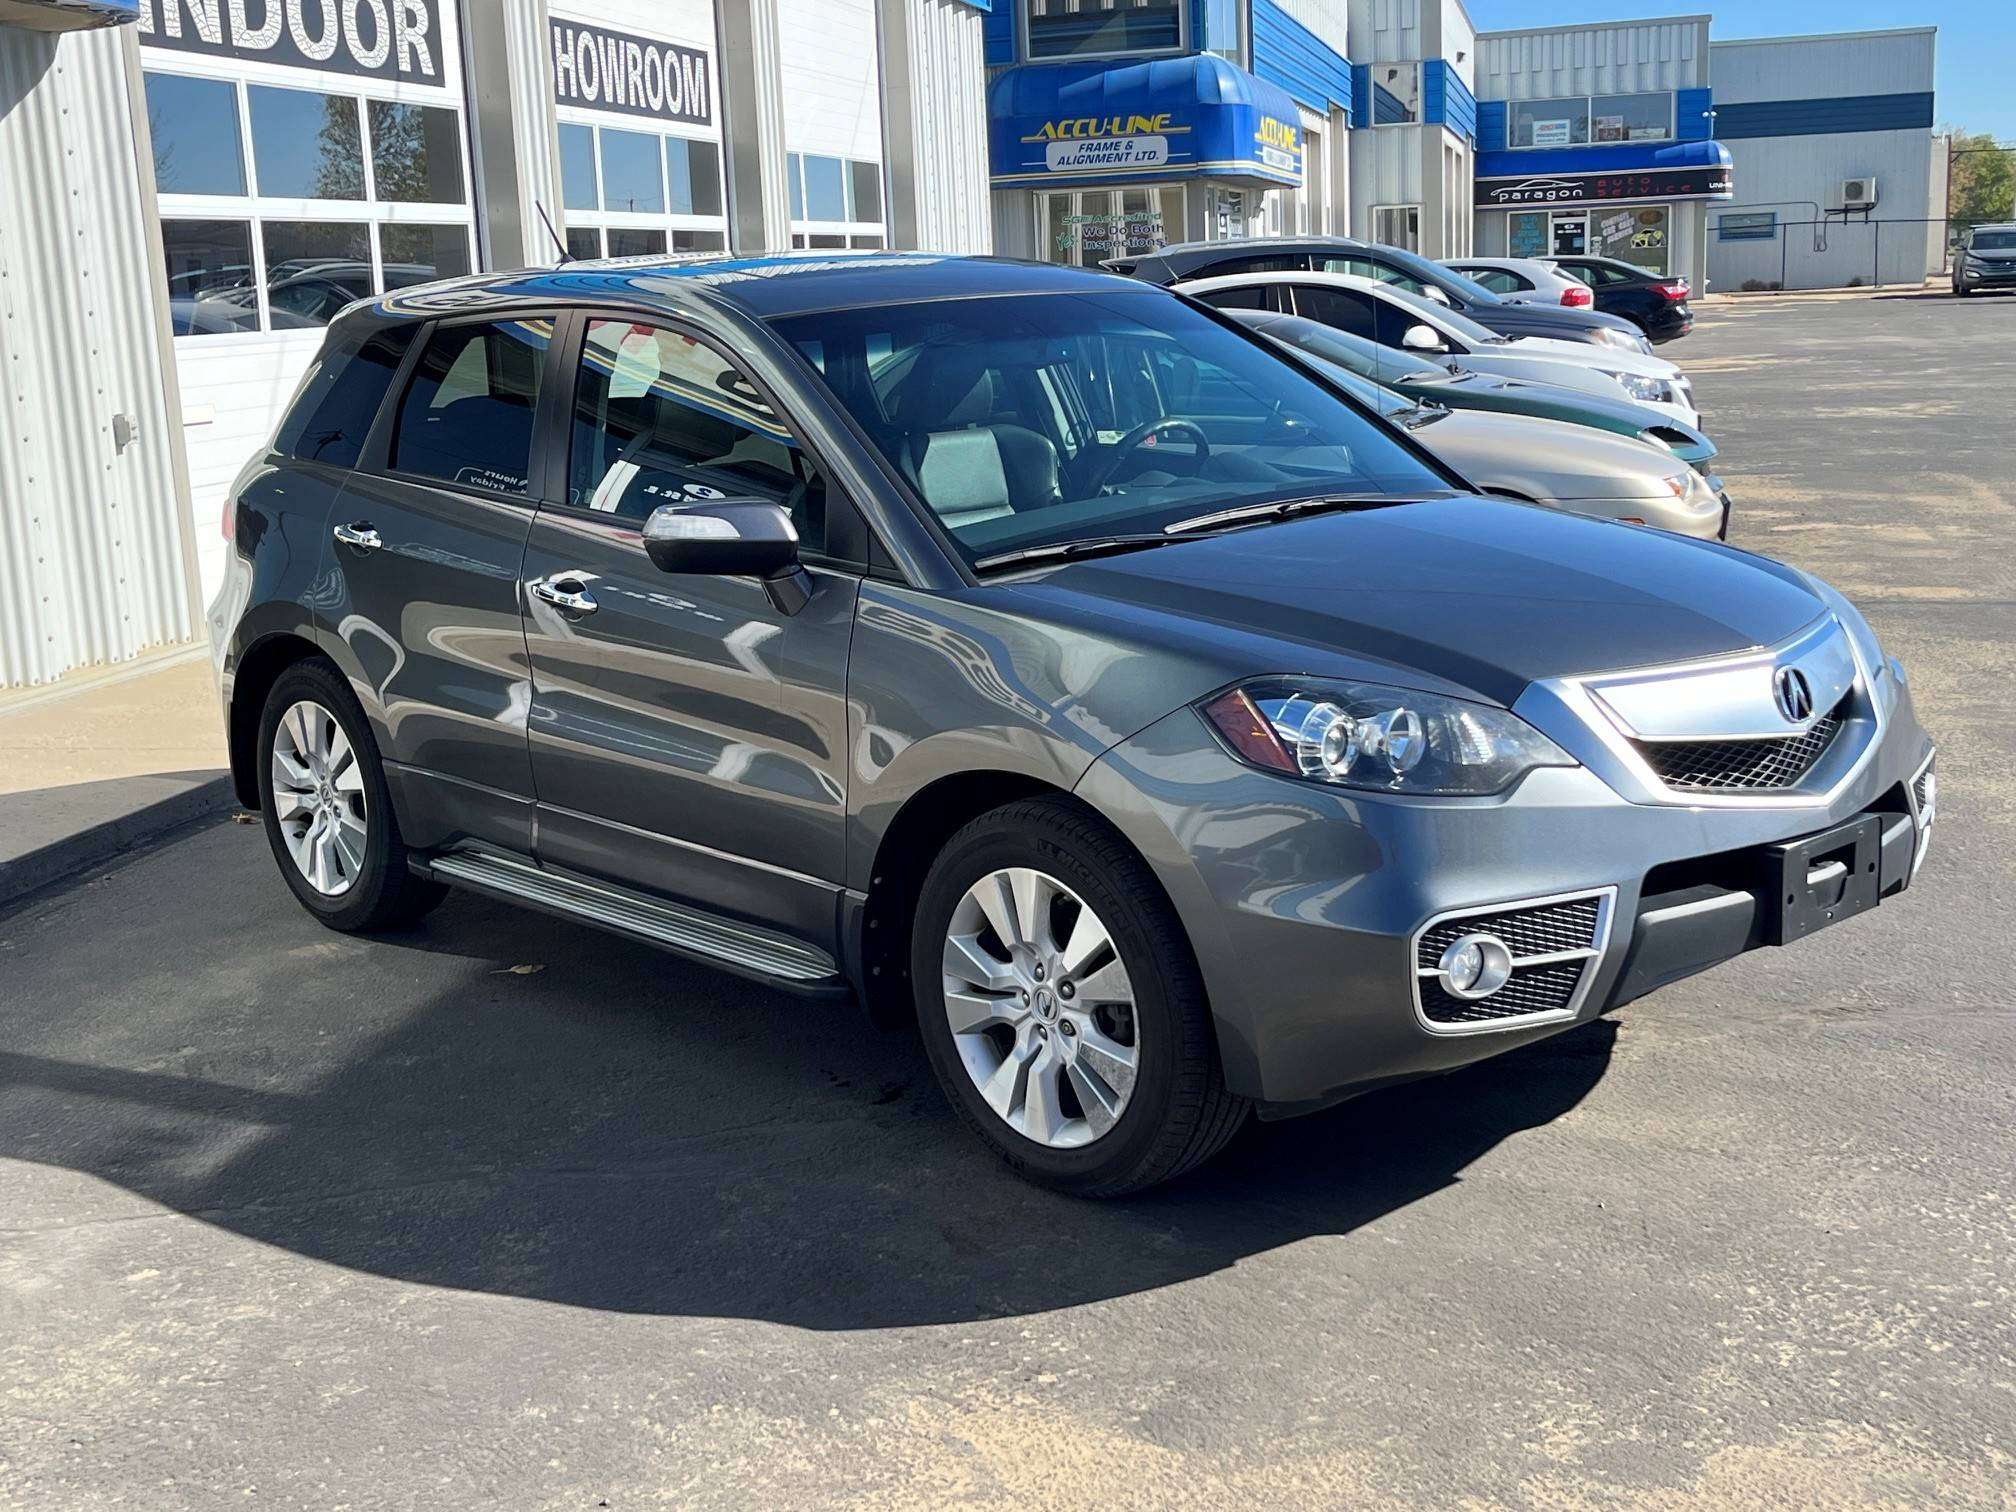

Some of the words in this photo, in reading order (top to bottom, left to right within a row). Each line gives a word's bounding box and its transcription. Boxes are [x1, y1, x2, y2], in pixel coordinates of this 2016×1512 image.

[552, 25, 707, 118] HOWROOM
[1022, 113, 1190, 142] ACCU-LINE
[1078, 141, 1120, 153] FRAME
[1124, 140, 1134, 151] &
[1056, 152, 1131, 166] ALIGNMENT
[1134, 150, 1159, 162] LTD.
[1597, 177, 1650, 188] auto
[1499, 188, 1583, 203] paragon
[1597, 184, 1693, 197] service
[1083, 226, 1106, 237] We
[1109, 225, 1127, 235] Do
[1131, 224, 1165, 235] Both
